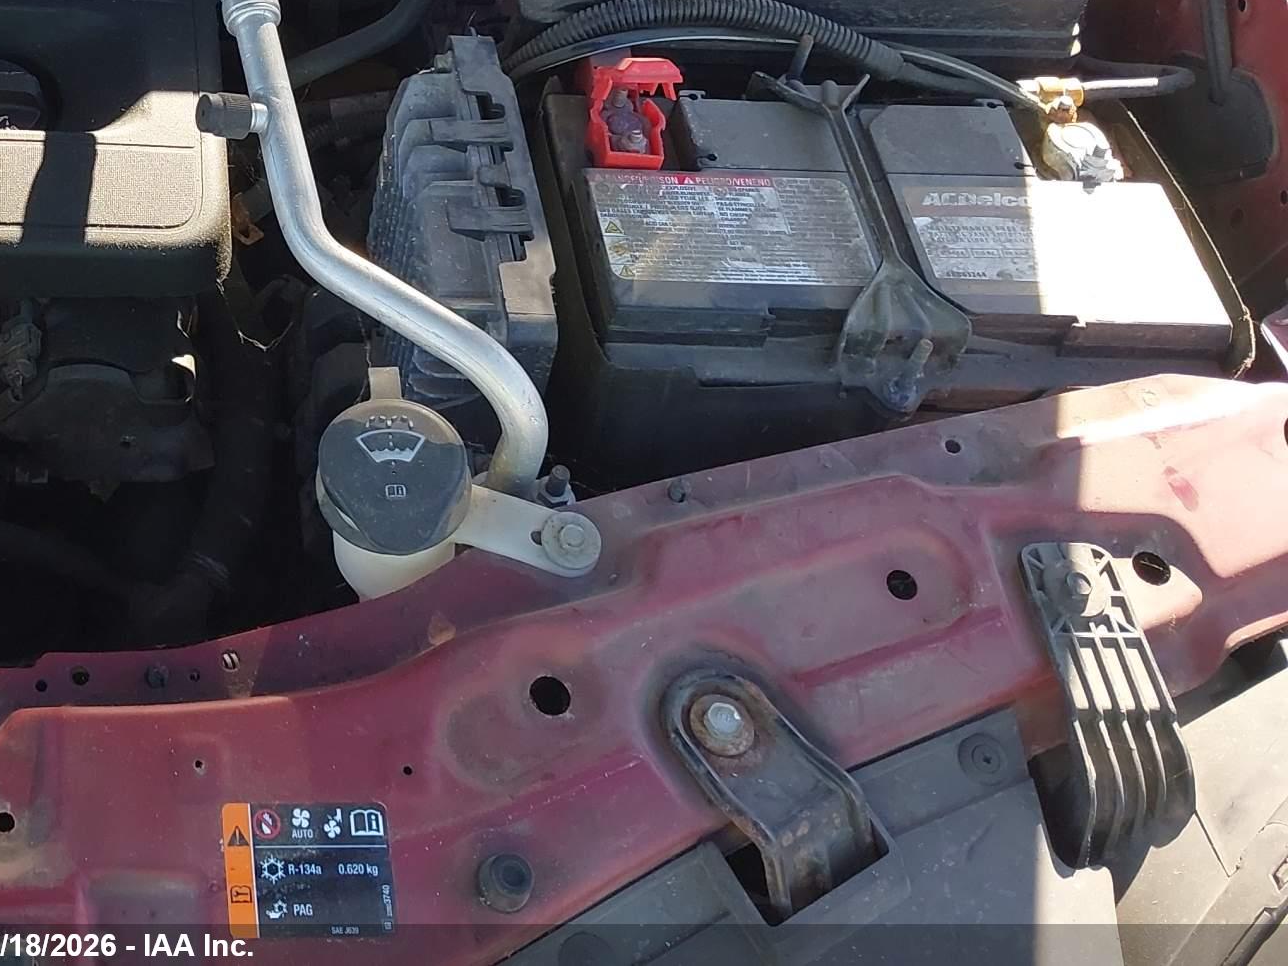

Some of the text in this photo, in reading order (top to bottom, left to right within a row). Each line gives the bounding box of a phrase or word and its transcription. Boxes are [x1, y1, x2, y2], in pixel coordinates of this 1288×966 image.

[921, 192, 1031, 207] ACDelco
[291, 829, 314, 839] AUTO
[288, 863, 379, 877] R-134a 0.620 kg
[293, 904, 313, 916] PAG
